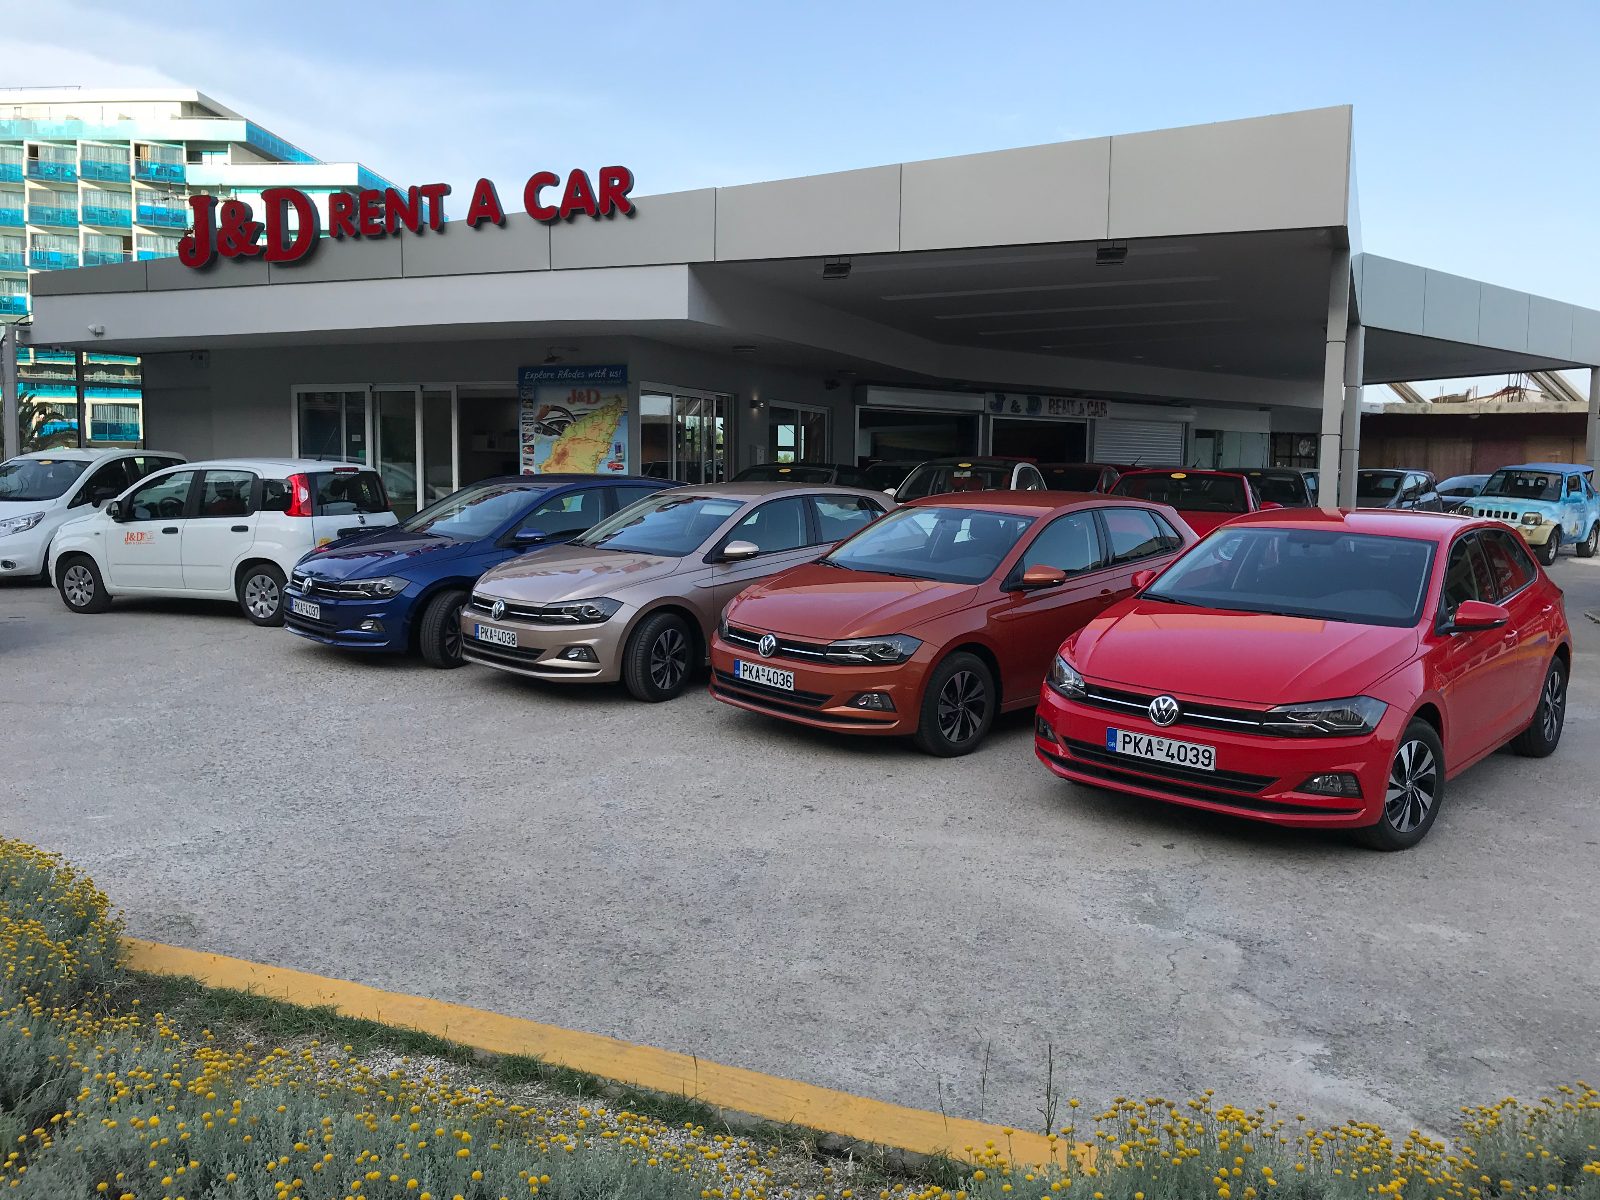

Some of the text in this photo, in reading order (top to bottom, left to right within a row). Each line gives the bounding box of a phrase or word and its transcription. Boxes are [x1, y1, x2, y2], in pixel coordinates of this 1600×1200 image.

[178, 165, 636, 269] J&D RENT A CAR
[524, 368, 623, 381] Explore Rhodes with us!
[567, 388, 601, 405] J&D
[742, 663, 793, 688] PKA-4036
[1122, 733, 1213, 767] PKA-4039
